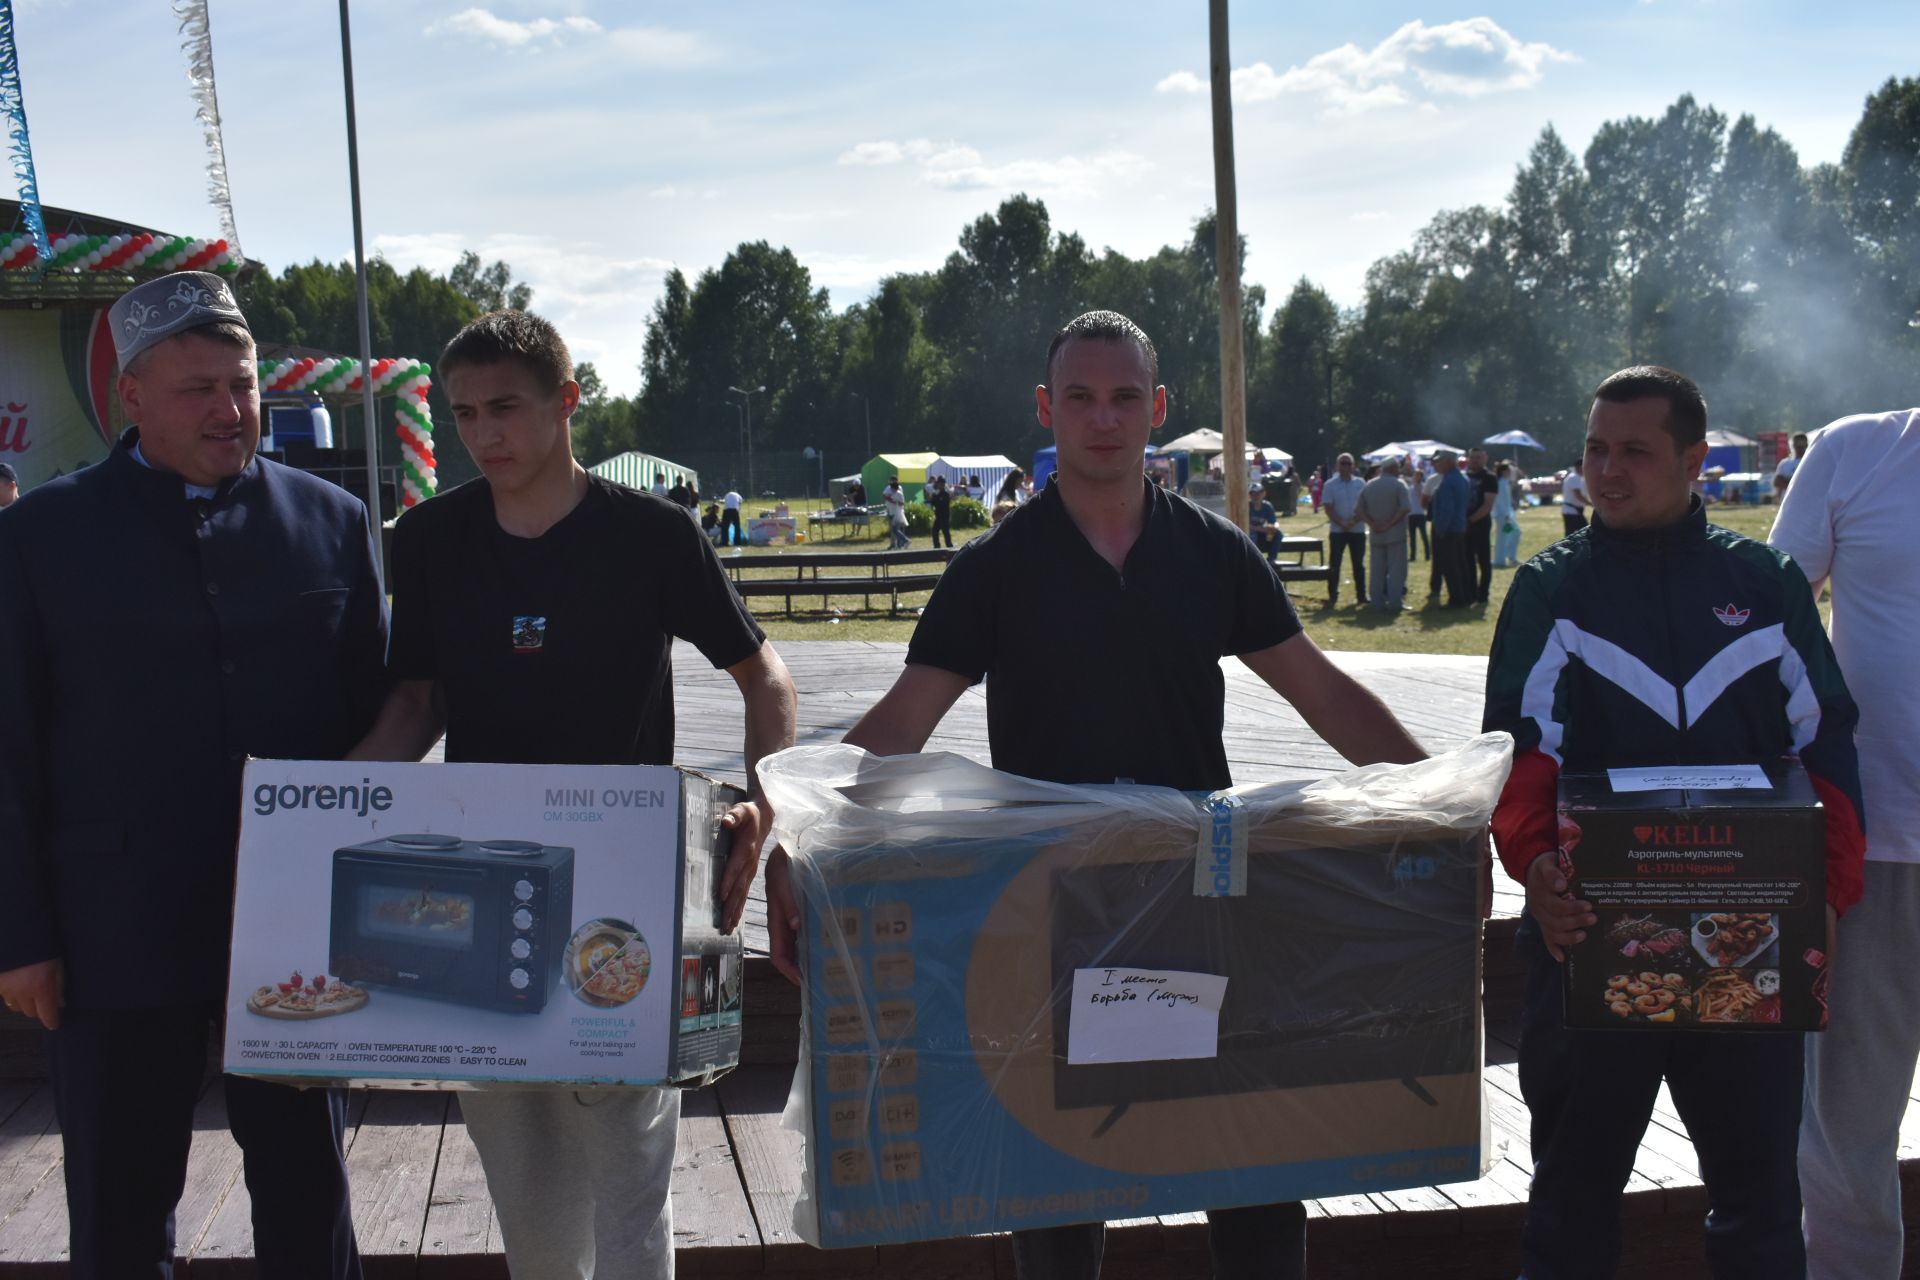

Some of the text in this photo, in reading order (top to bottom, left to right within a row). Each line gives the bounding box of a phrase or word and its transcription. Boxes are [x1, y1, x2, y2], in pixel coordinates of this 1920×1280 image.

[253, 777, 393, 817] gorenje
[545, 789, 665, 808] MINI OVEN
[543, 810, 604, 822] OM 30GBX
[1654, 824, 1734, 845] KELLI
[1627, 848, 1744, 860] Аэрогриль-мультипечь
[1637, 861, 1735, 876] KL-1710 Черный
[1121, 974, 1168, 984] место
[571, 1016, 626, 1027] POWERFUL
[577, 1028, 628, 1039] COMPACT
[261, 1040, 270, 1049] W
[279, 1040, 338, 1050] 30 L CAPACITY
[348, 1042, 372, 1052] OVEN
[374, 1043, 437, 1053] TEMPERATURE
[438, 1045, 453, 1053] 100
[471, 1045, 485, 1054] 220
[588, 1041, 602, 1049] your
[603, 1041, 622, 1049] baking
[241, 1050, 320, 1061] CONVECTION OVEN
[329, 1053, 450, 1064] 2 ELECTRIC COOKING ZONES
[580, 1049, 604, 1058] cooking
[460, 1056, 527, 1067] EASY TO CLEAN
[939, 1195, 990, 1224] LED
[996, 1183, 1150, 1218] телевизор
